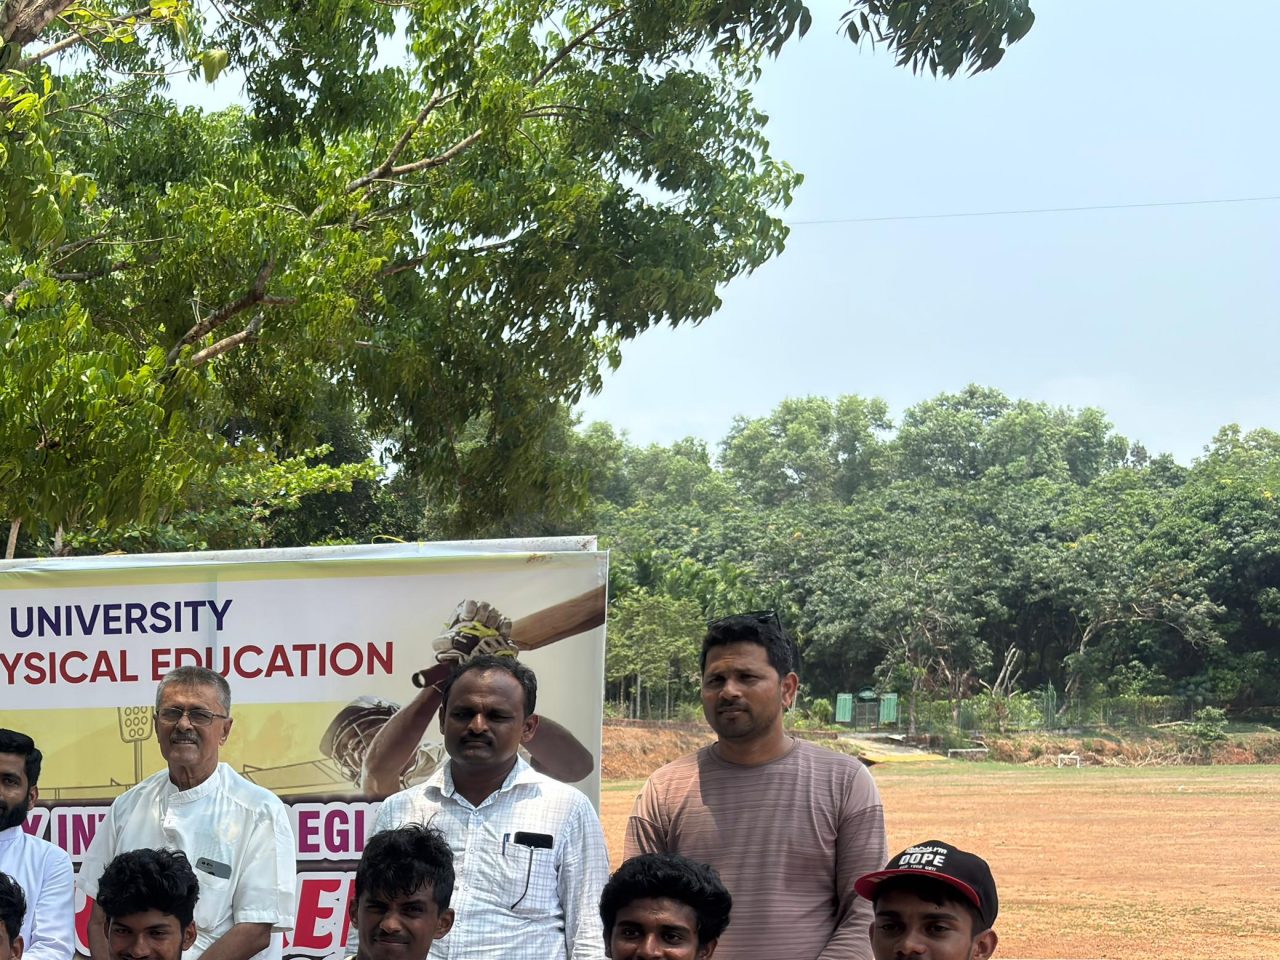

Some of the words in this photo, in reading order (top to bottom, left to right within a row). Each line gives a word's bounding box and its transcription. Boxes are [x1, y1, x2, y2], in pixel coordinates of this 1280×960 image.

[10, 600, 233, 638] UNIVERSITY
[151, 641, 394, 681] EDUCATION
[898, 853, 946, 867] DOPE
